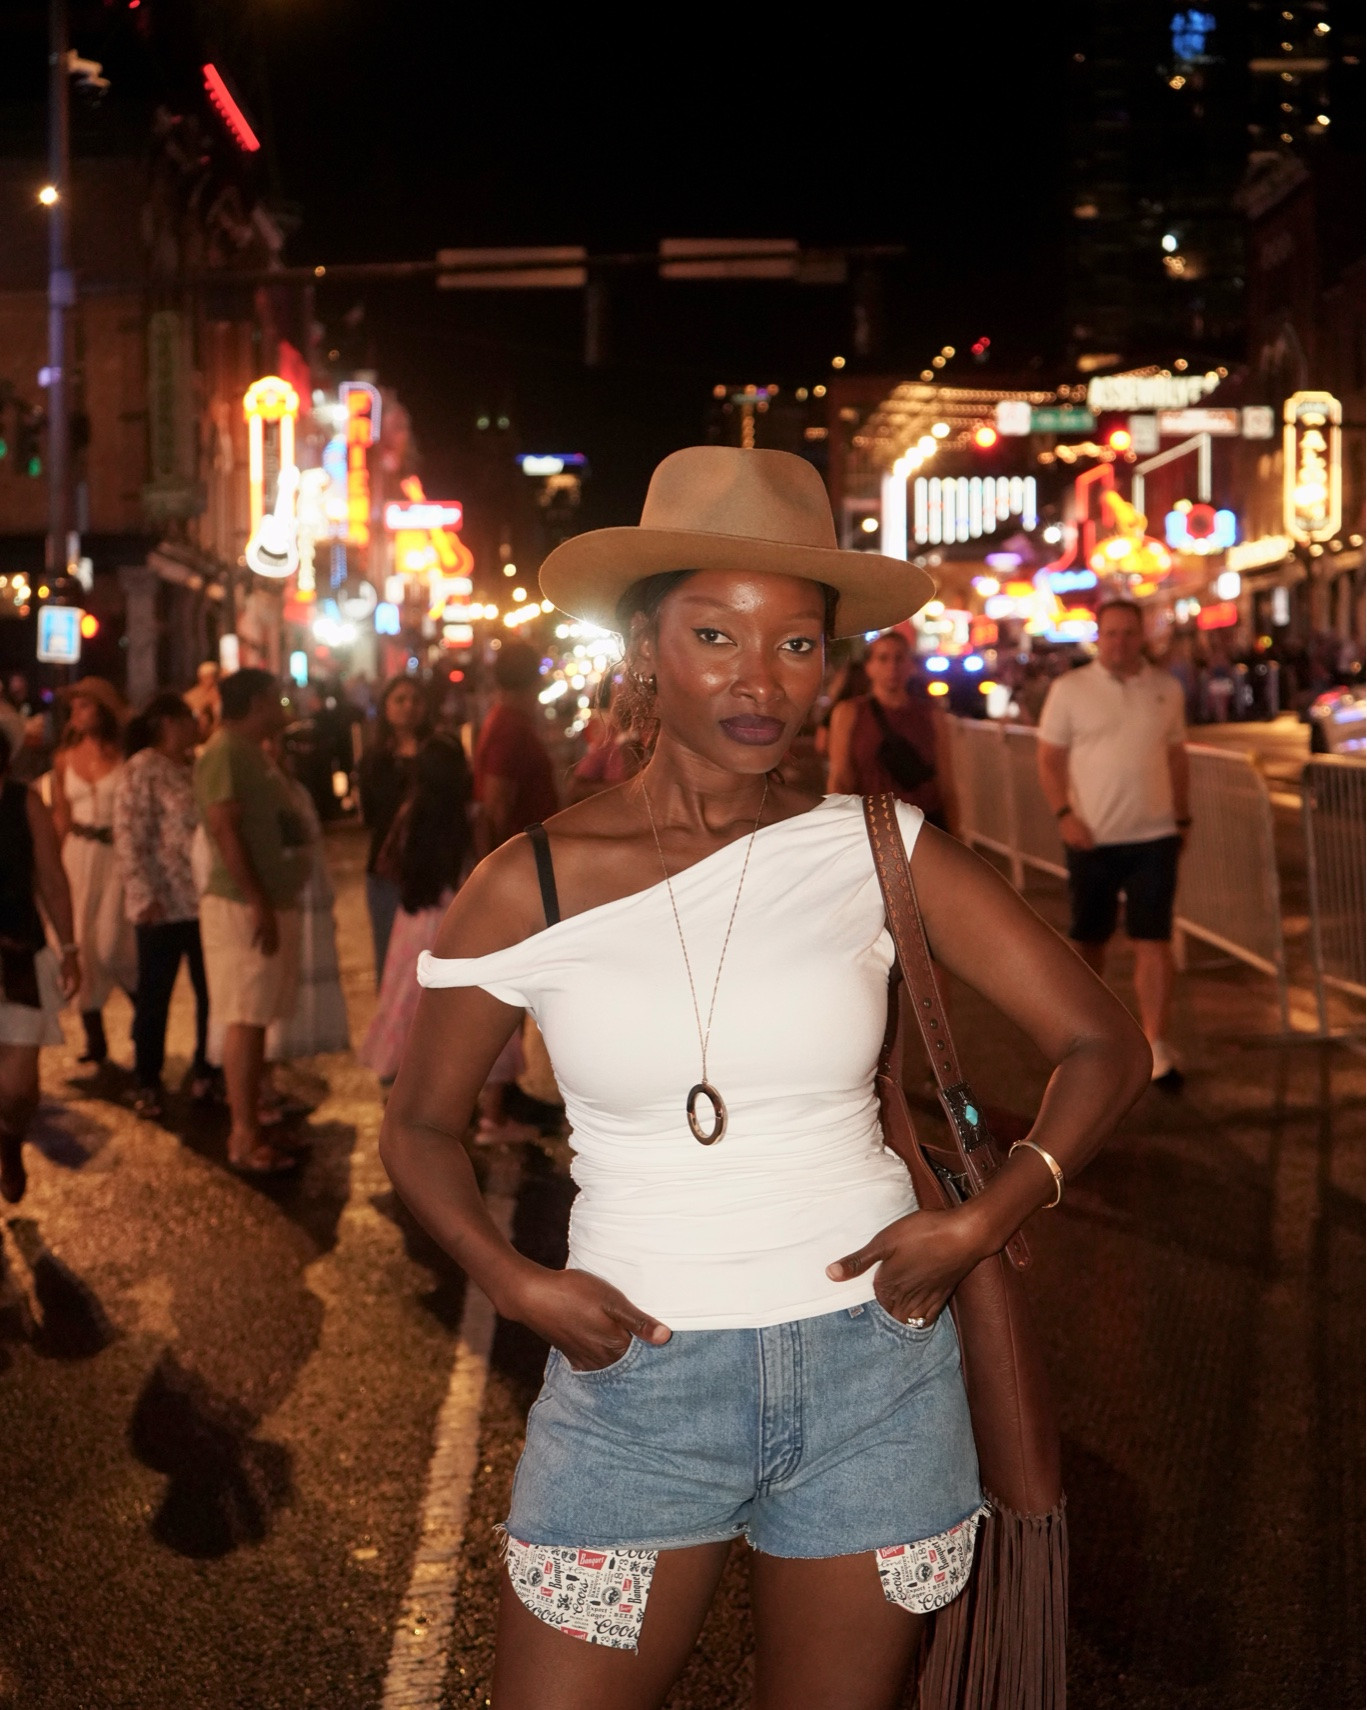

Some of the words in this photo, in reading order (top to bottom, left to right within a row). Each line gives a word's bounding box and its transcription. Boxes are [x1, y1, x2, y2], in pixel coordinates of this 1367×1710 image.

[549, 1557, 564, 1589] Banquet
[580, 1553, 604, 1567] Banquet
[614, 1559, 629, 1584] 1873
[572, 1579, 588, 1615] Coors
[628, 1574, 643, 1604] Banquet
